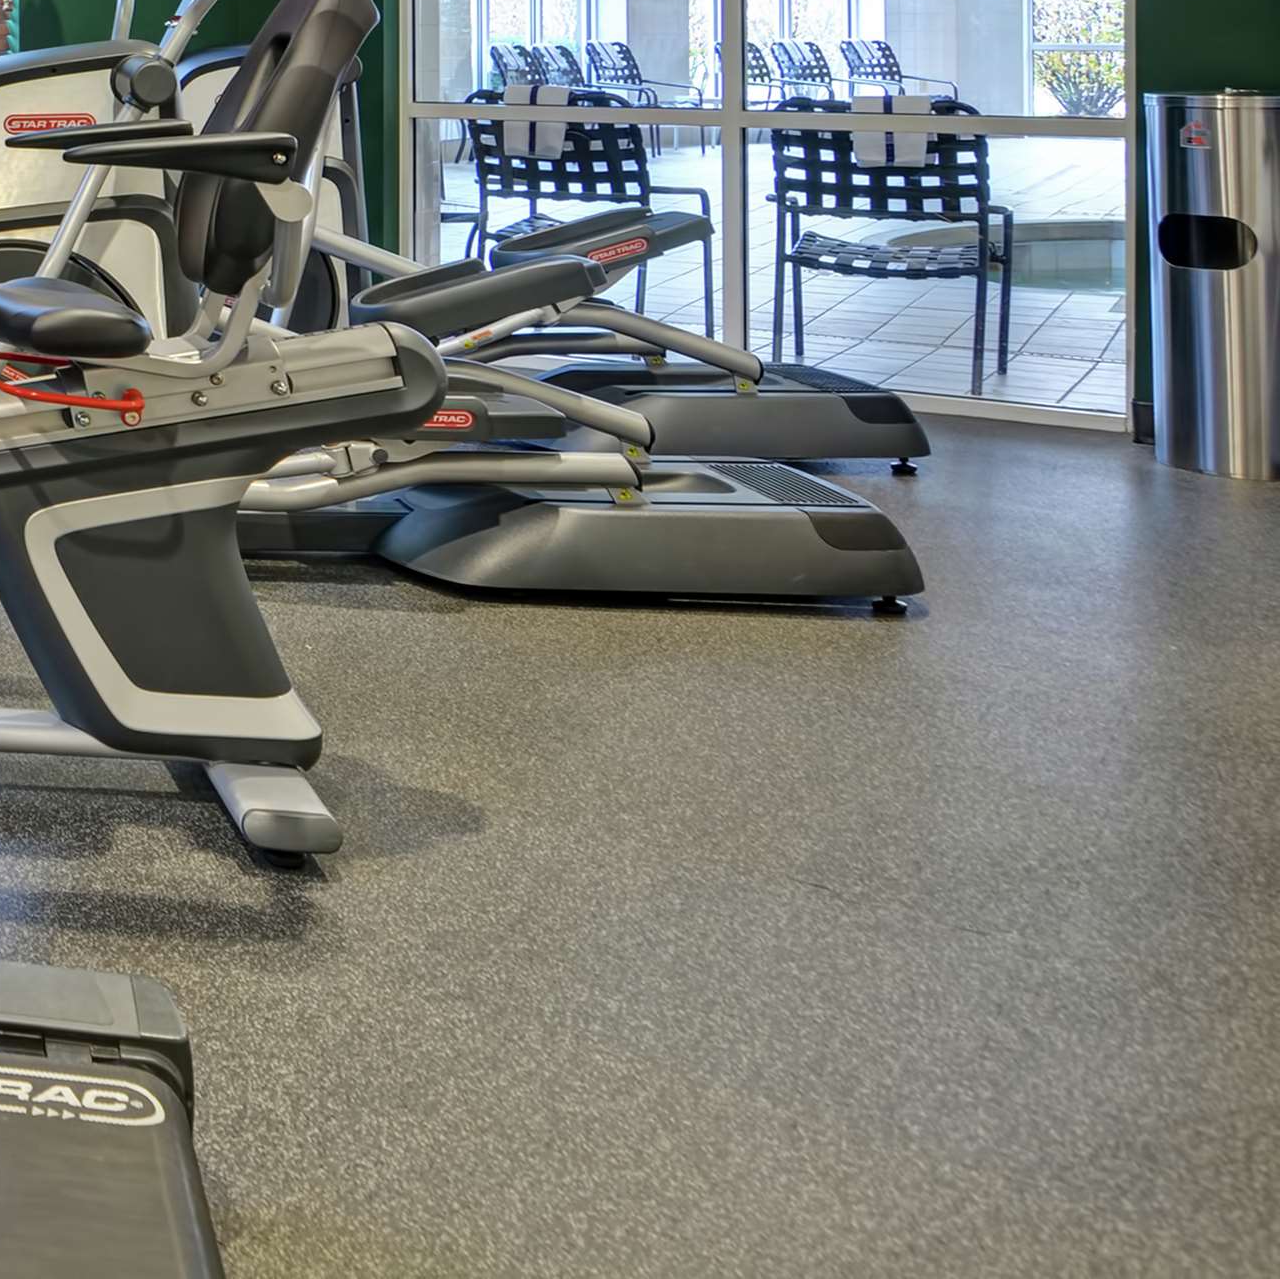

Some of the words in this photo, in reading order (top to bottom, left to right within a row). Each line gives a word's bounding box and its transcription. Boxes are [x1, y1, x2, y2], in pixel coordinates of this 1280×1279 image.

[8, 120, 47, 128] STAR
[49, 119, 88, 127] TRAC
[433, 415, 465, 423] TRAC
